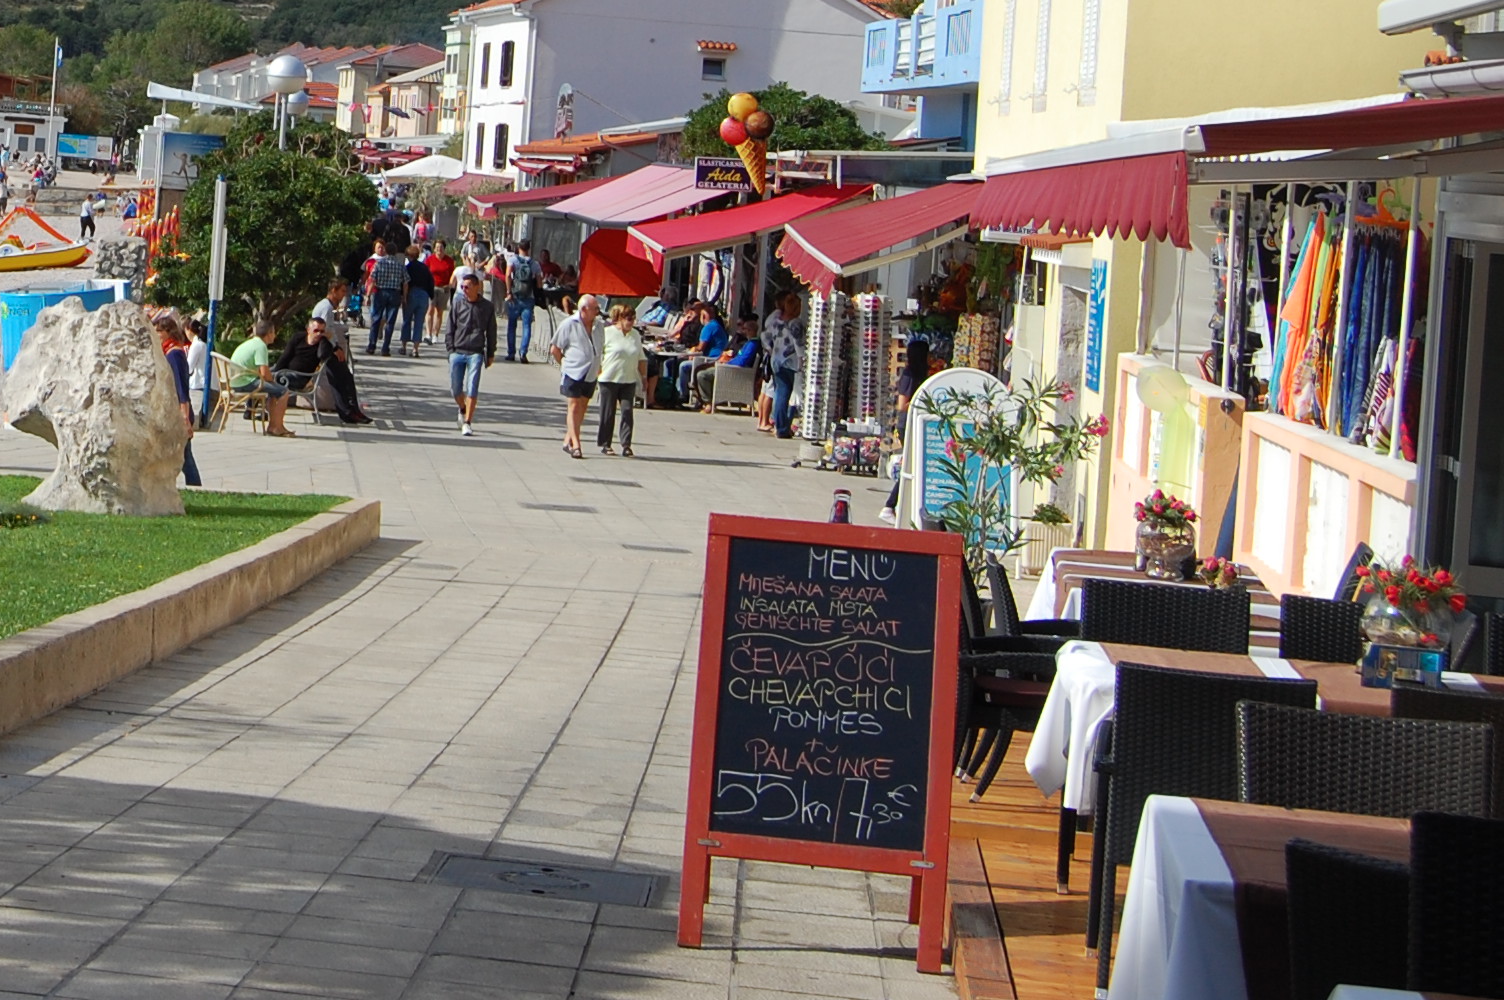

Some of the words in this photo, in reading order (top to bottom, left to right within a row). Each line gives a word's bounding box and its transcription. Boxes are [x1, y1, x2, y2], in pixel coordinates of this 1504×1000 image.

[697, 181, 750, 190] GELATERIA
[705, 167, 743, 182] Aida
[738, 572, 824, 598] MIJEŠANA
[829, 585, 888, 603] SALATA
[739, 595, 819, 617] INSALATA
[829, 600, 878, 618] MISTA
[734, 612, 836, 633] GEMISCHTE
[841, 618, 902, 637] SALAT
[768, 705, 884, 735] POMMES
[744, 738, 895, 779] PALAČINKE
